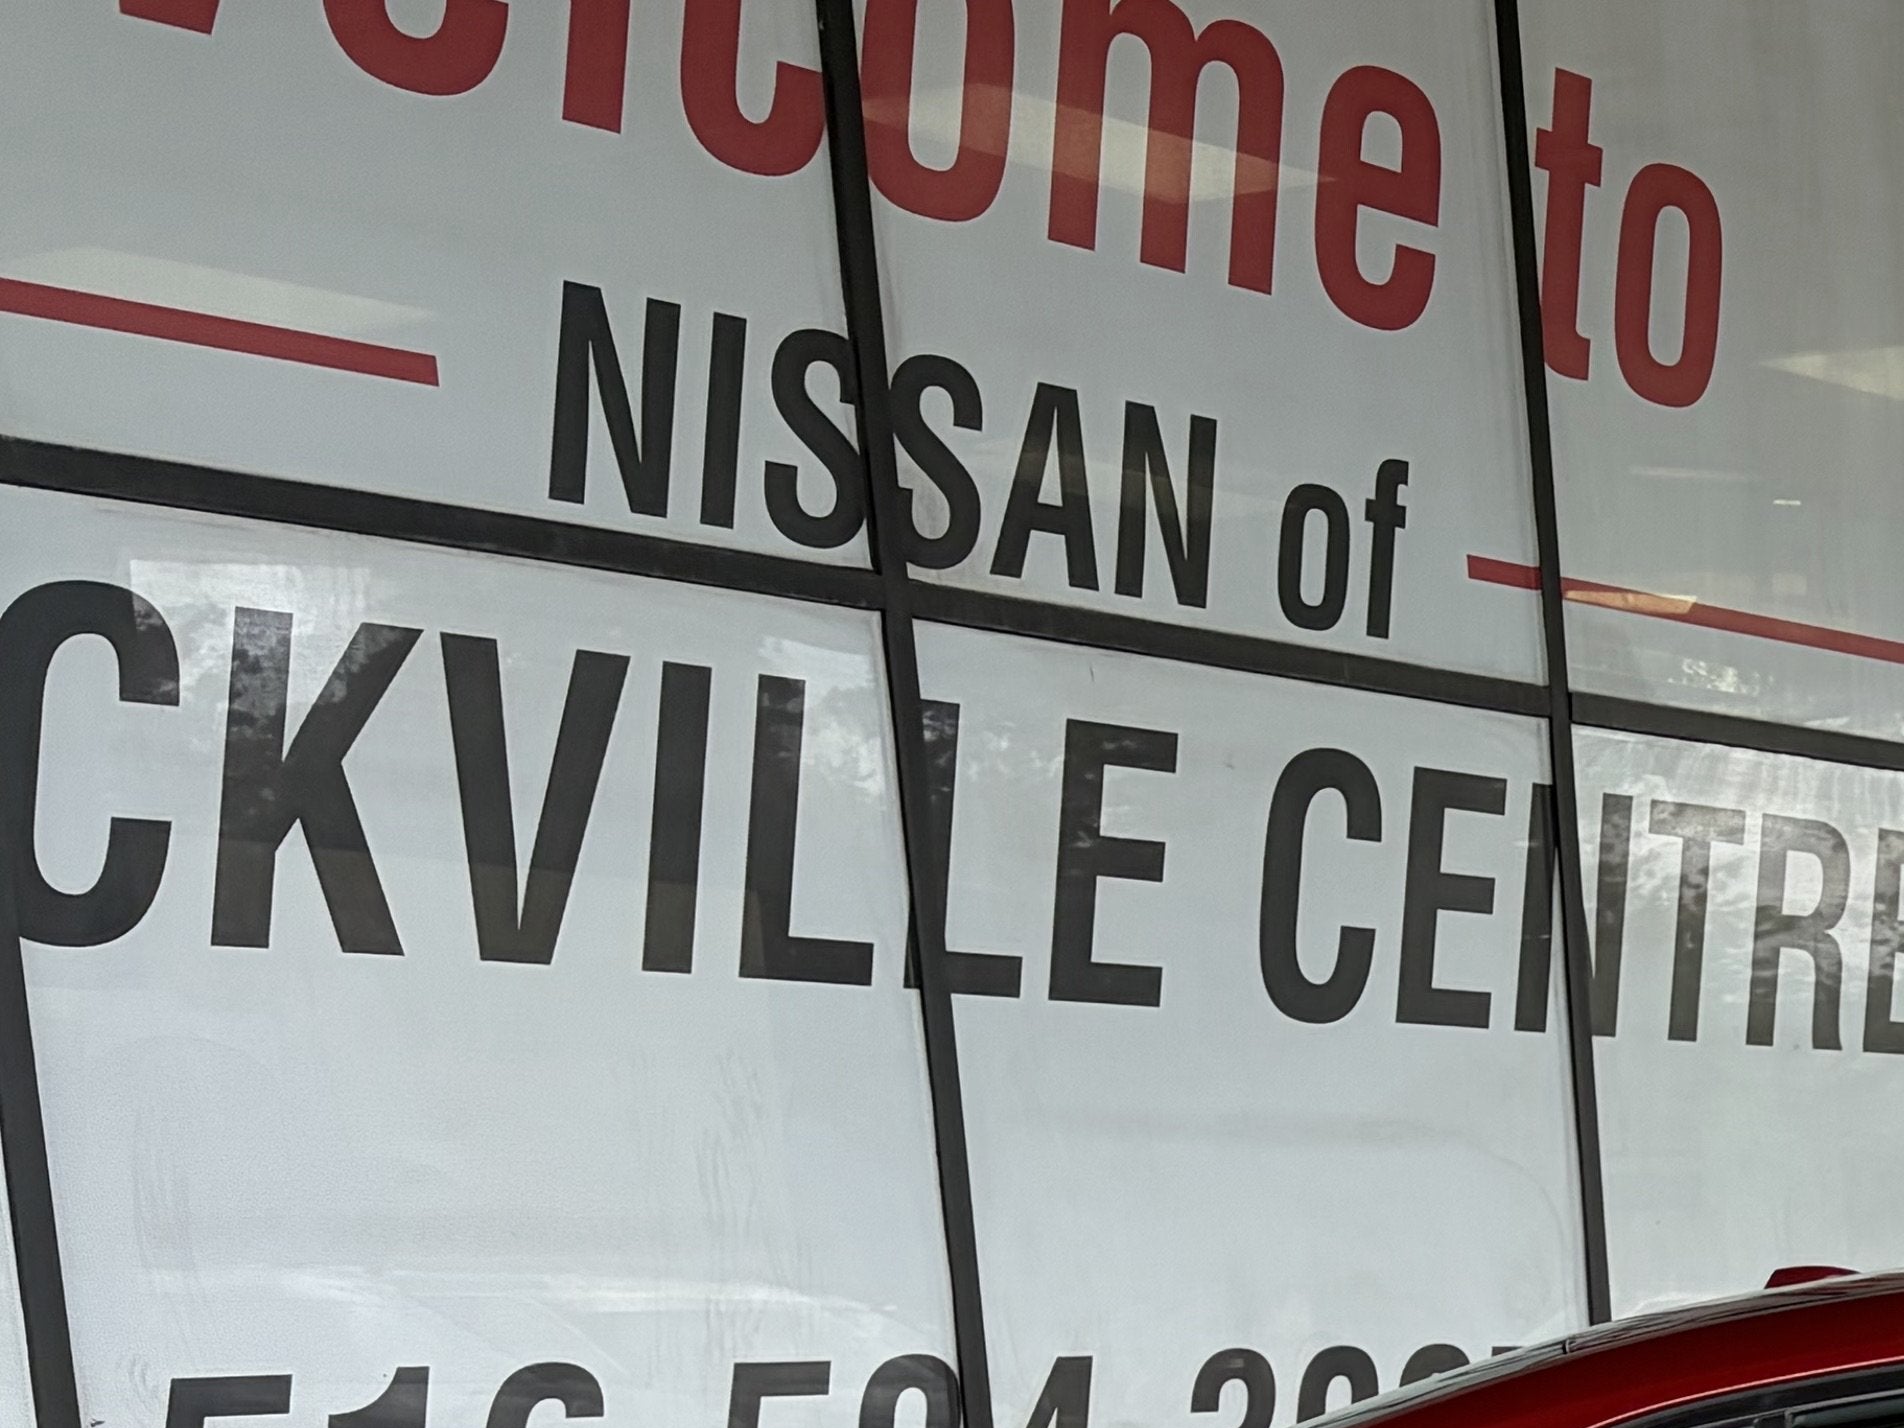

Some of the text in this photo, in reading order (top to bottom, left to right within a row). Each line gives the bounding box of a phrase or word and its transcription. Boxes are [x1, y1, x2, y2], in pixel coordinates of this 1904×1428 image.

[117, 0, 1723, 409] come to
[548, 280, 1410, 639] NISSAN of
[0, 579, 1179, 1008] CKVILLE
